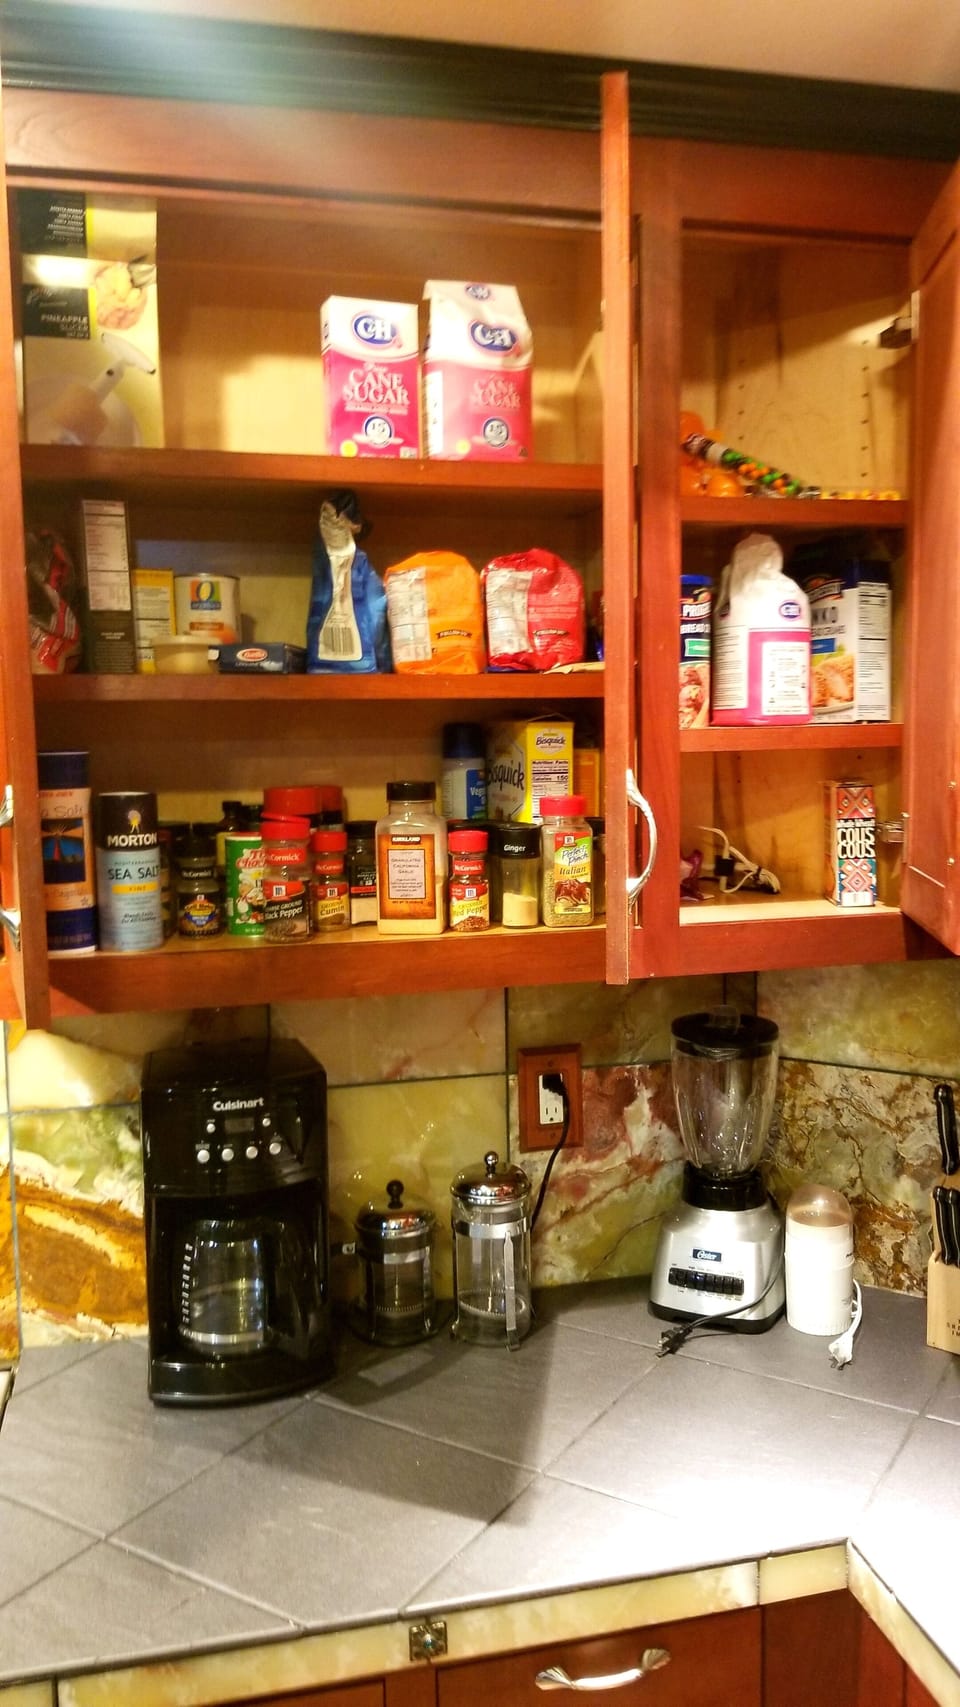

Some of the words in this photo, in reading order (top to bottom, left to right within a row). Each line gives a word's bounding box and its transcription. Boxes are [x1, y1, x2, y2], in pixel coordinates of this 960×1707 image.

[41, 314, 89, 323] PINEAPPLE
[356, 317, 393, 341] C&H
[473, 324, 514, 348] C&H
[349, 368, 404, 390] CANE
[343, 383, 410, 405] SUGAR
[474, 379, 515, 398] CANE
[470, 390, 521, 409] SUGAR
[536, 736, 567, 747] Bisquick
[107, 832, 158, 848] MORTON
[838, 828, 875, 842] COUS
[504, 844, 526, 855] Ginger
[562, 845, 587, 860] Perfect
[838, 841, 876, 858] COUS
[107, 867, 132, 881] SEA
[559, 866, 587, 876] Italian
[281, 899, 303, 908] GROUND
[320, 904, 346, 917] Cumin
[280, 905, 304, 920] Pepper
[213, 1097, 264, 1112] Cuisinart
